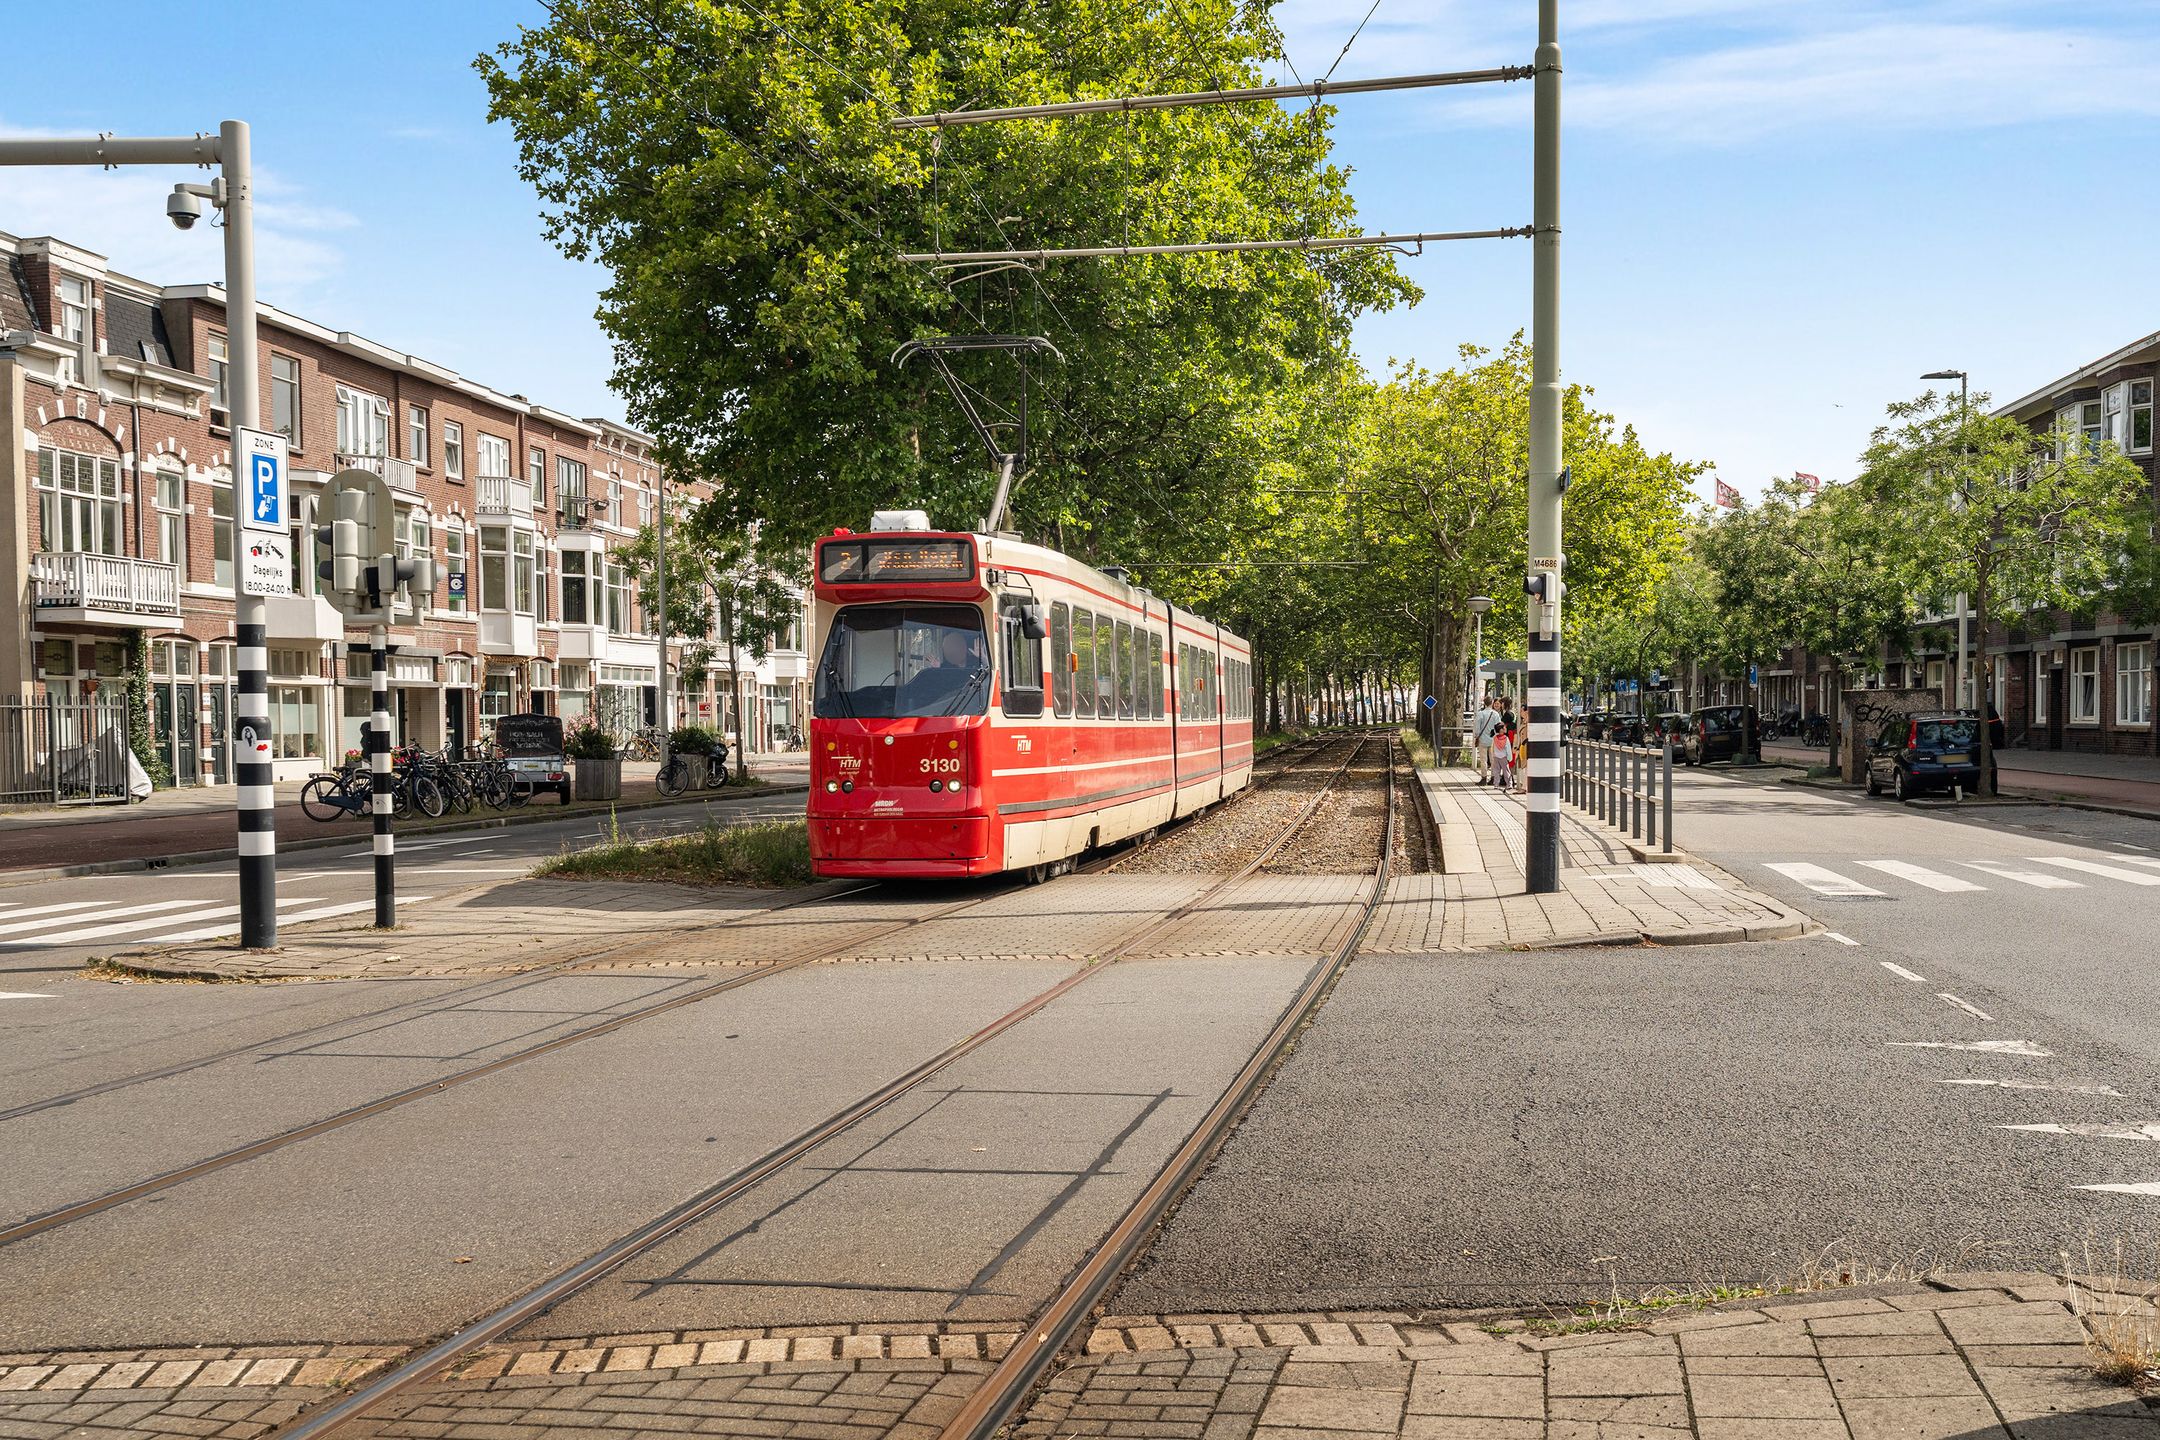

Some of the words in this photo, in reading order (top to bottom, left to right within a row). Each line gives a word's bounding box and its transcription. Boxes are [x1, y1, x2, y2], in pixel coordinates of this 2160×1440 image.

[254, 438, 274, 450] ZONE
[257, 459, 274, 494] P
[253, 564, 283, 580] Dagelijks
[1017, 739, 1032, 752] HTM
[840, 759, 861, 768] HTM
[920, 758, 960, 773] 3130
